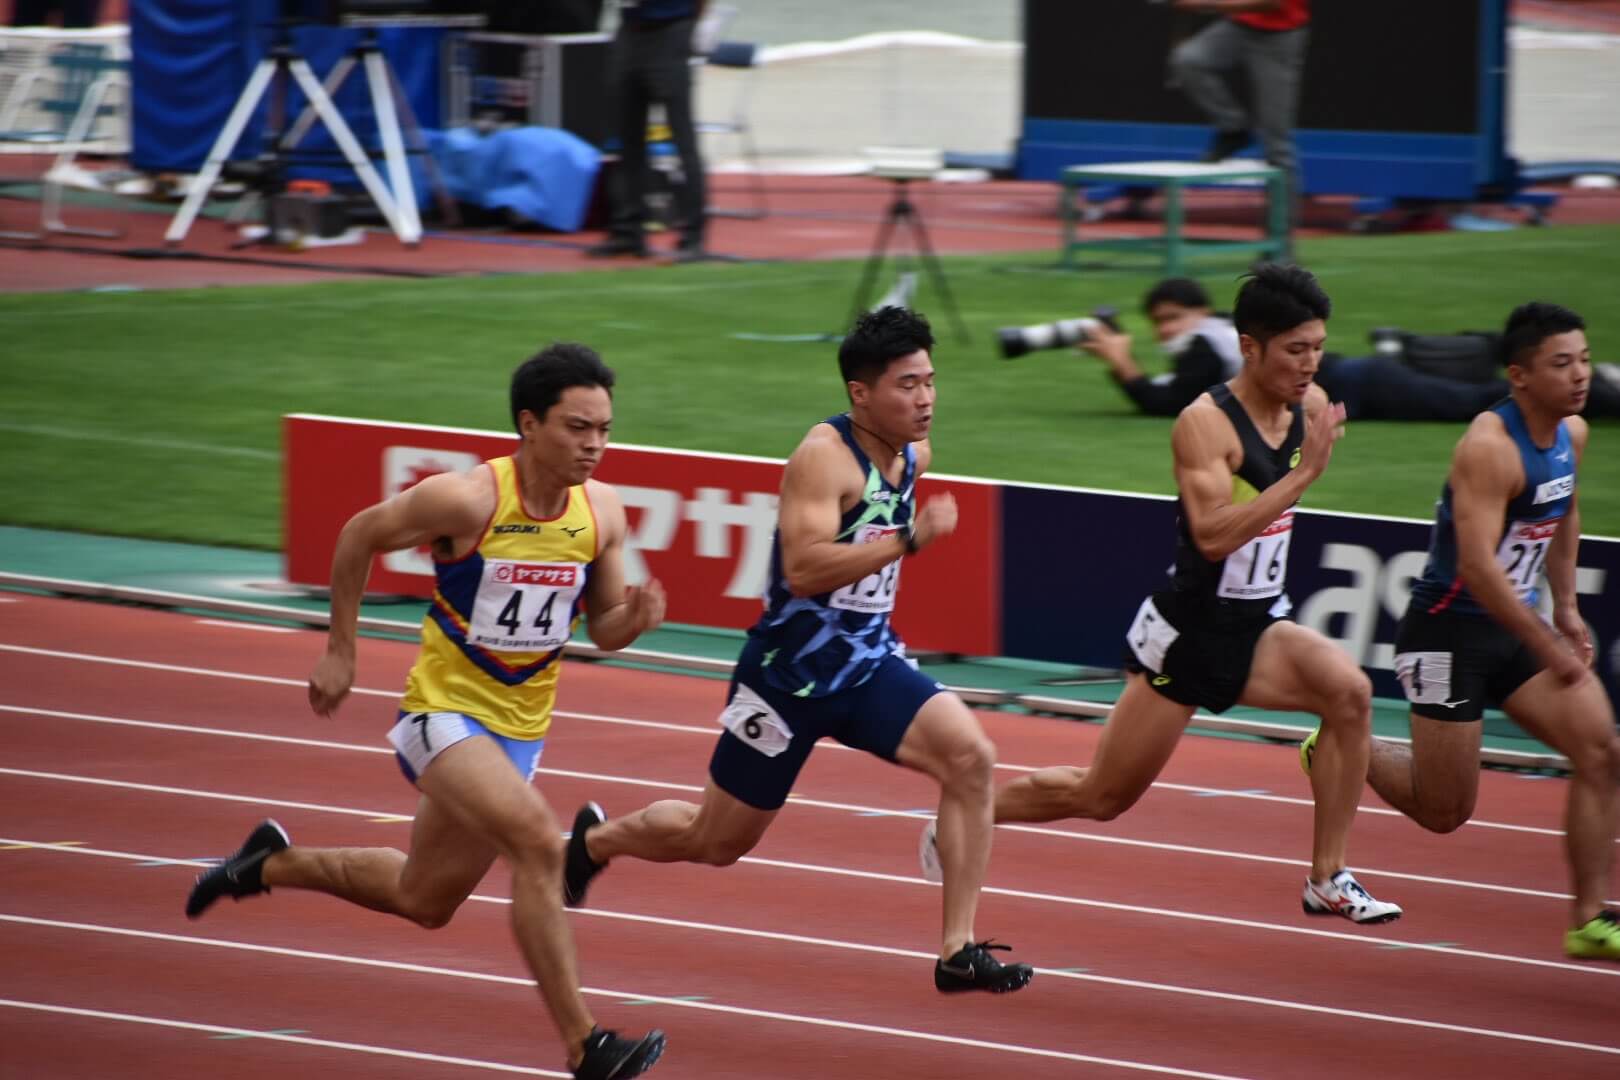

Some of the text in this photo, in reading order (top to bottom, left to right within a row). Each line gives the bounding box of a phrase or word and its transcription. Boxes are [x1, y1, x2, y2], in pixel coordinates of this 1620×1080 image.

[494, 524, 541, 534] SUZUKI
[1247, 539, 1285, 586] 16
[496, 589, 559, 637] 44
[411, 713, 432, 752] 7
[745, 711, 769, 740] 6
